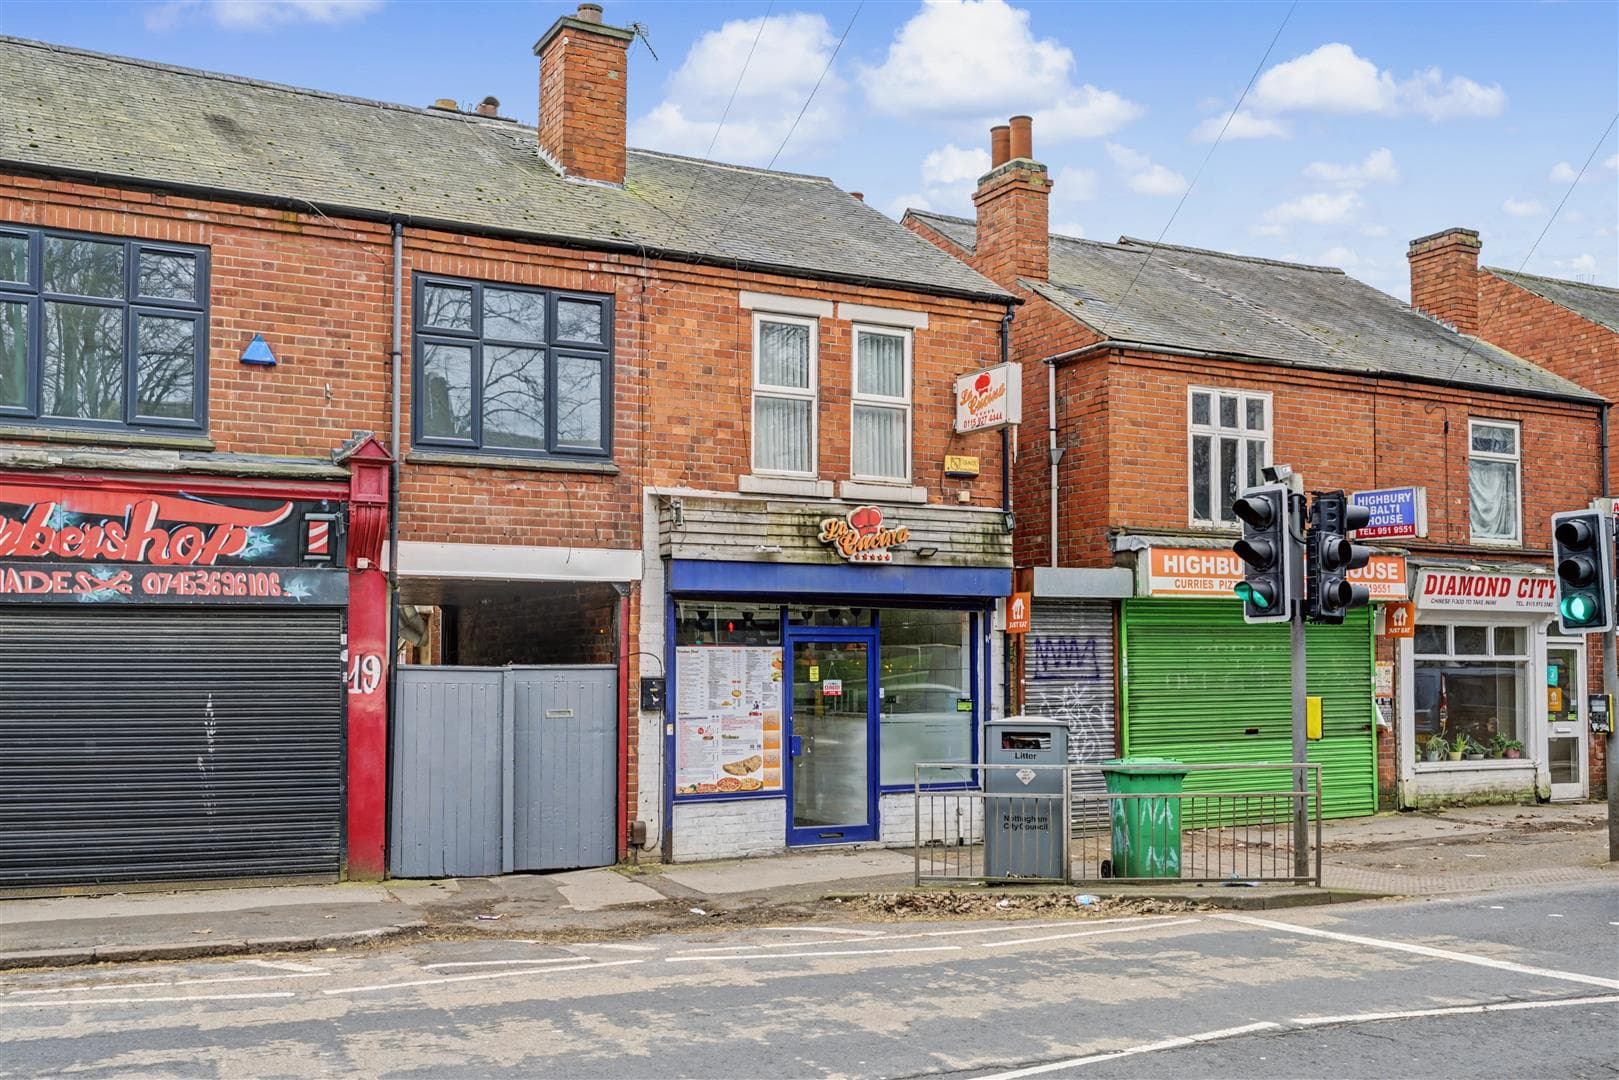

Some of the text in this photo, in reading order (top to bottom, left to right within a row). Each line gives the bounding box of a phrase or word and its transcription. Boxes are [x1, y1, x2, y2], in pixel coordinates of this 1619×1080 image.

[1357, 492, 1412, 506] HIGHBURY
[1370, 503, 1400, 515] BALTI
[1367, 514, 1404, 526] HOUSE
[0, 500, 248, 566] rbershop
[1359, 525, 1412, 536] TEL: 951 9551
[1163, 554, 1399, 580] HIGHBU OUSE
[0, 568, 89, 593] ADES
[1174, 578, 1214, 589] CURRIES
[1219, 580, 1238, 590] PIZ
[1424, 574, 1557, 599] DIAMOND CITY
[1009, 620, 1028, 629] JUST EAT
[348, 654, 381, 695] 19
[1014, 751, 1038, 760] Litter
[1003, 823, 1019, 832] Cty
